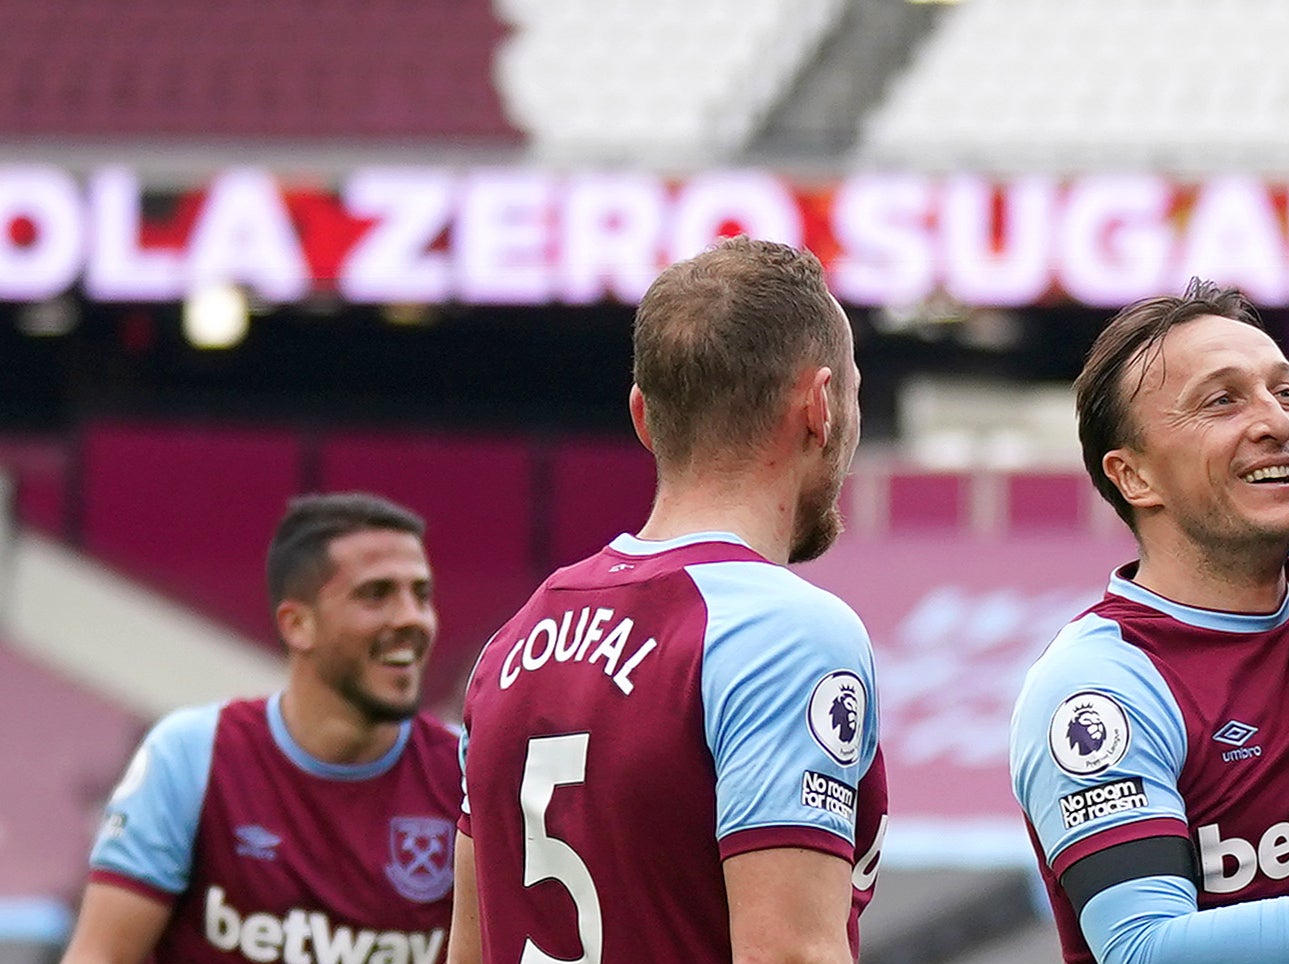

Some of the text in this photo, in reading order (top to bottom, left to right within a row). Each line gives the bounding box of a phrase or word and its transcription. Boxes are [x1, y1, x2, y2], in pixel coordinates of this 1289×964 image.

[0, 165, 306, 303] OLA
[499, 606, 658, 696] COUFAL
[1222, 745, 1263, 763] umbro
[802, 787, 826, 809] for
[803, 771, 854, 807] No room
[1060, 781, 1137, 814] No room
[1064, 809, 1087, 829] for
